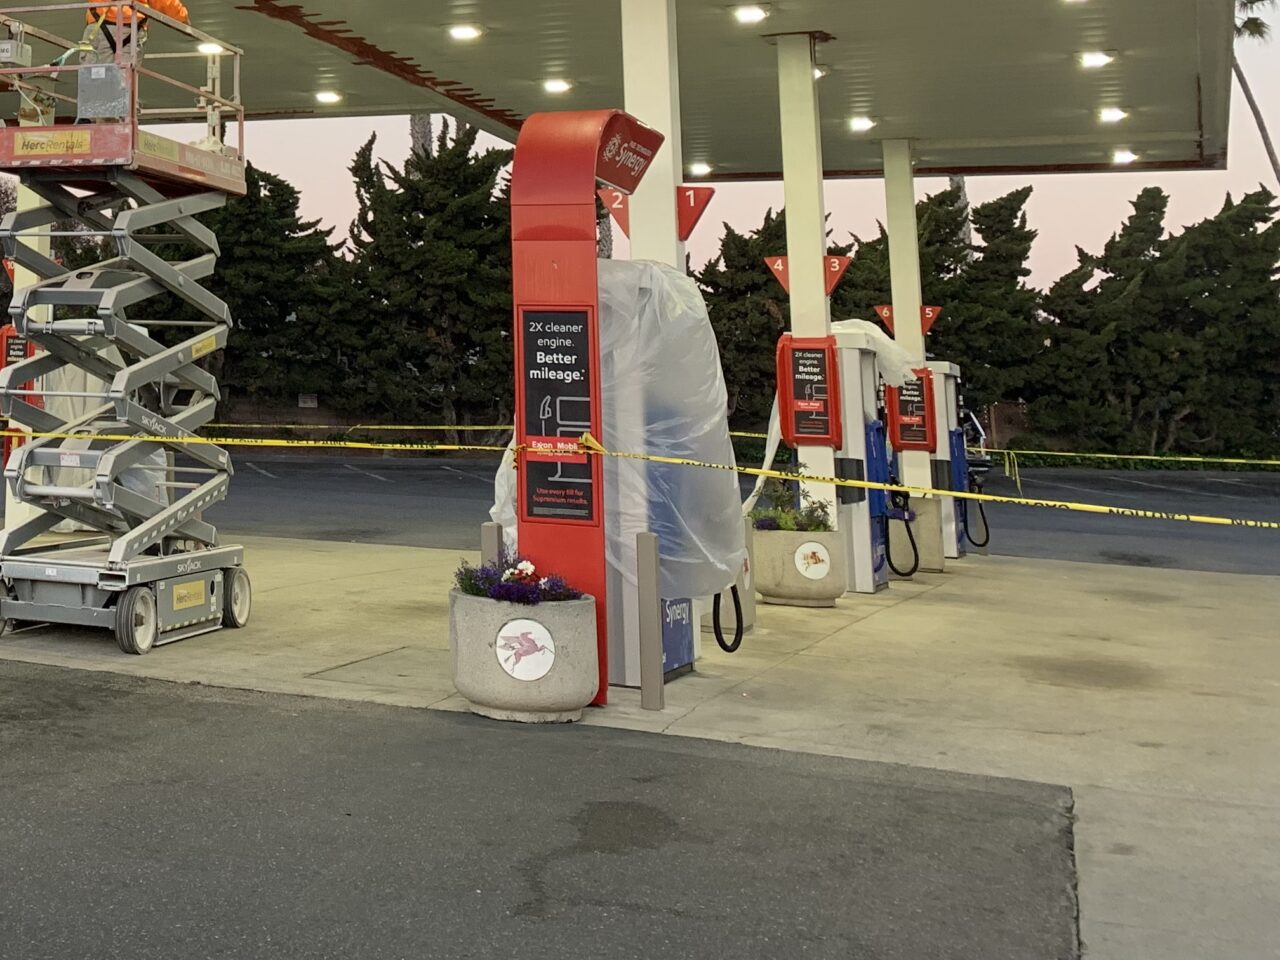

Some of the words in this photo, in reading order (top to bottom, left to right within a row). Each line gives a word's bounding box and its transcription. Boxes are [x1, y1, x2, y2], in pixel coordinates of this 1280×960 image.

[616, 142, 647, 177] Synergy
[611, 191, 624, 208] 2
[685, 189, 695, 207] 1
[773, 258, 784, 272] 4
[830, 258, 840, 272] 3
[882, 308, 890, 317] 6
[925, 307, 933, 318] 5
[529, 321, 543, 332] 2X
[545, 321, 583, 333] cleaner
[537, 336, 575, 349] engine.
[536, 351, 578, 364] Better
[798, 365, 821, 373] Better
[531, 440, 553, 450] Exxon
[177, 558, 202, 573] SKYJACK
[665, 600, 690, 628] Synergy
